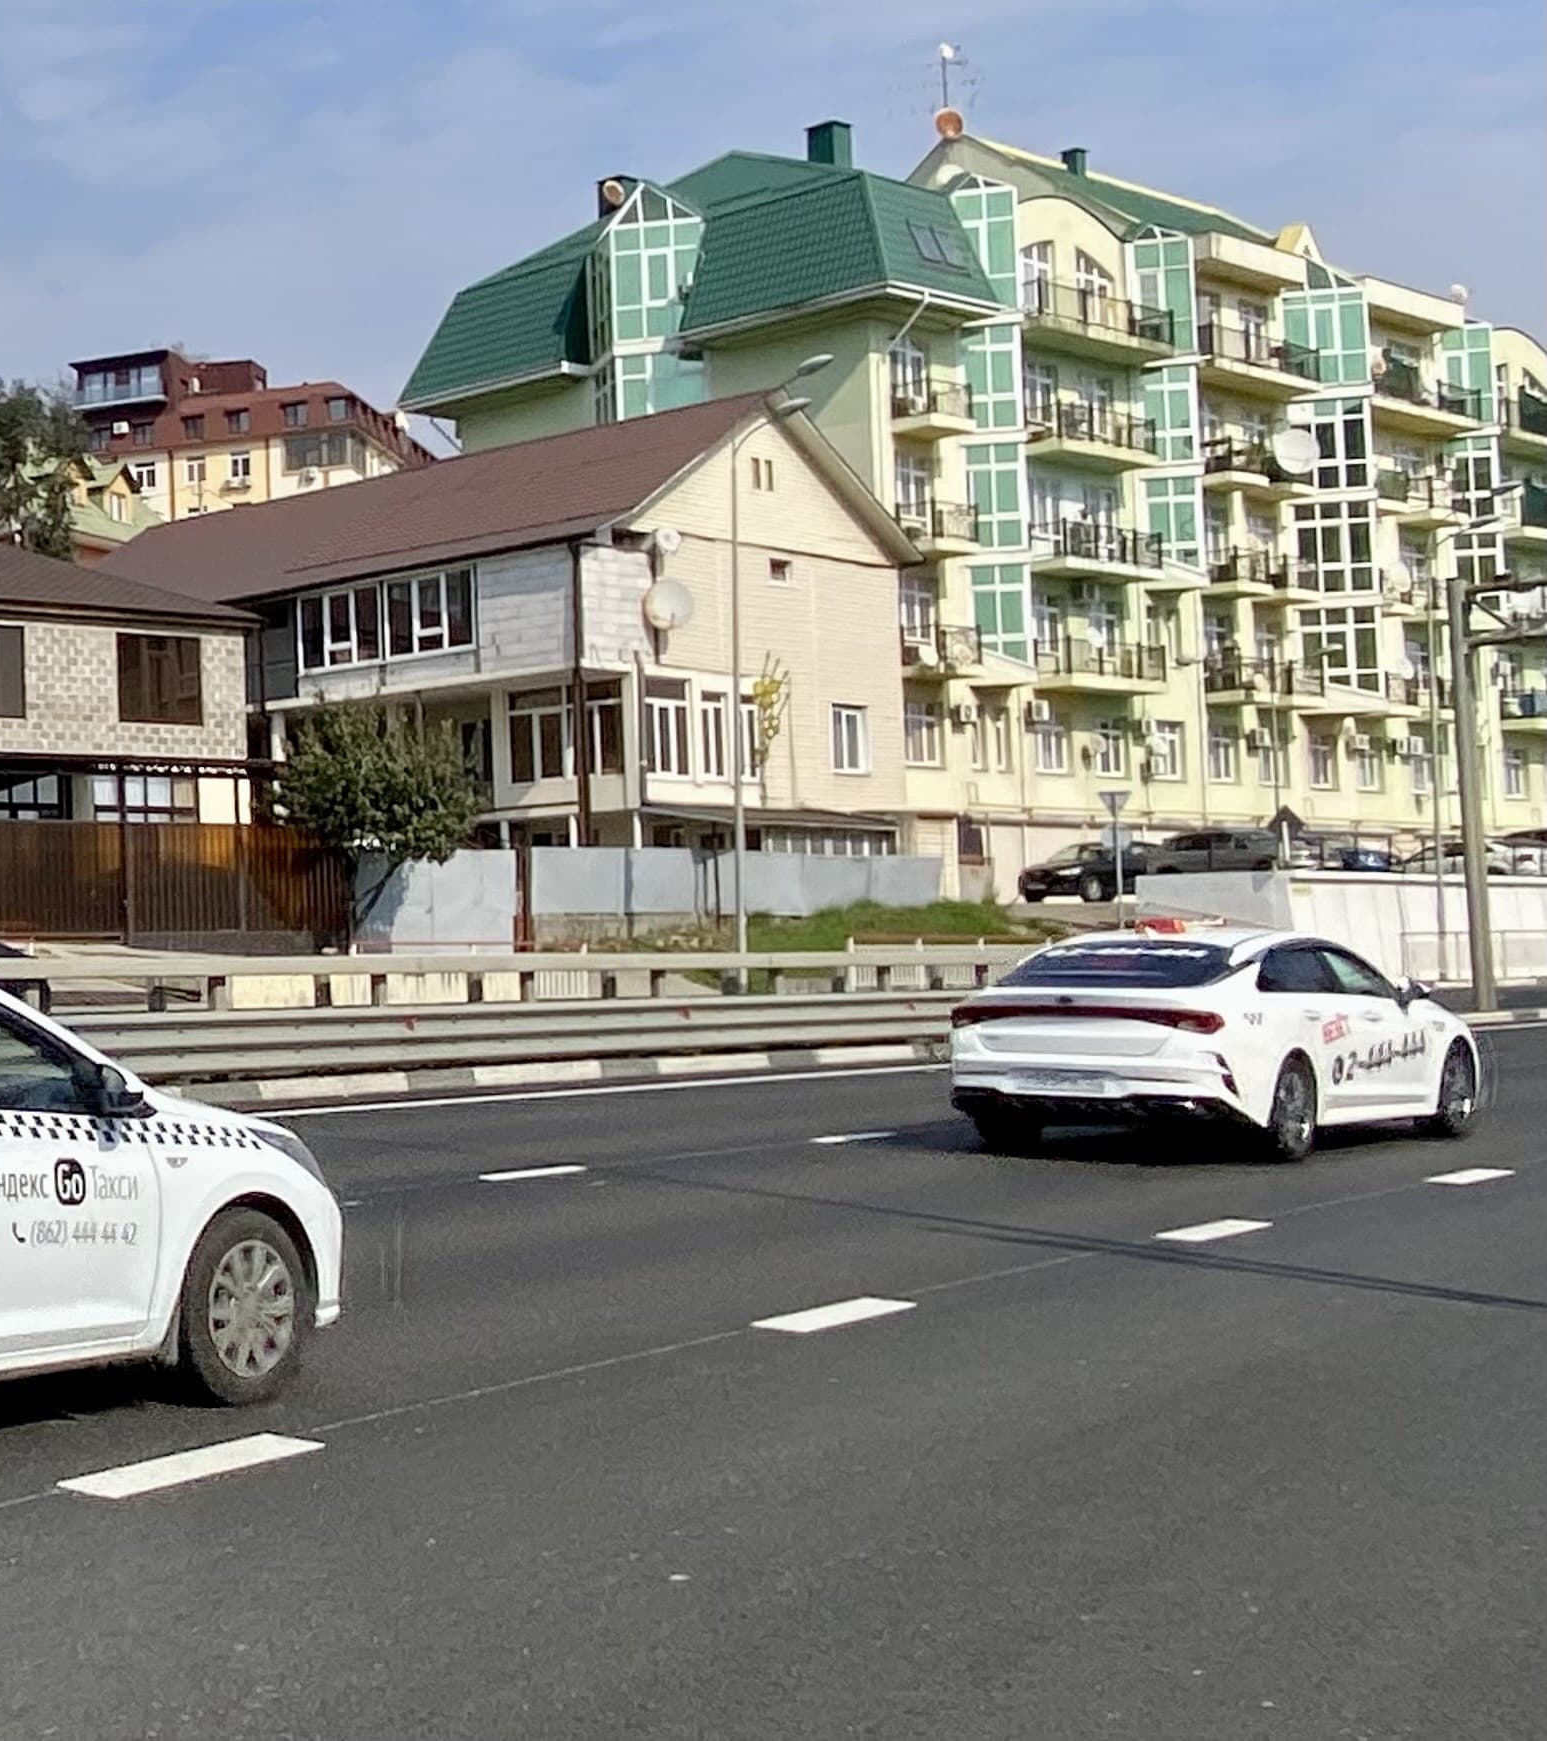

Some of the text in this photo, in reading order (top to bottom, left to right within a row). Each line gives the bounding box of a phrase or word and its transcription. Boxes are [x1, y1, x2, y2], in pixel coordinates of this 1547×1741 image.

[89, 1164, 139, 1201] Такси
[30, 1219, 69, 1248] (862)
[72, 1220, 97, 1245] 444
